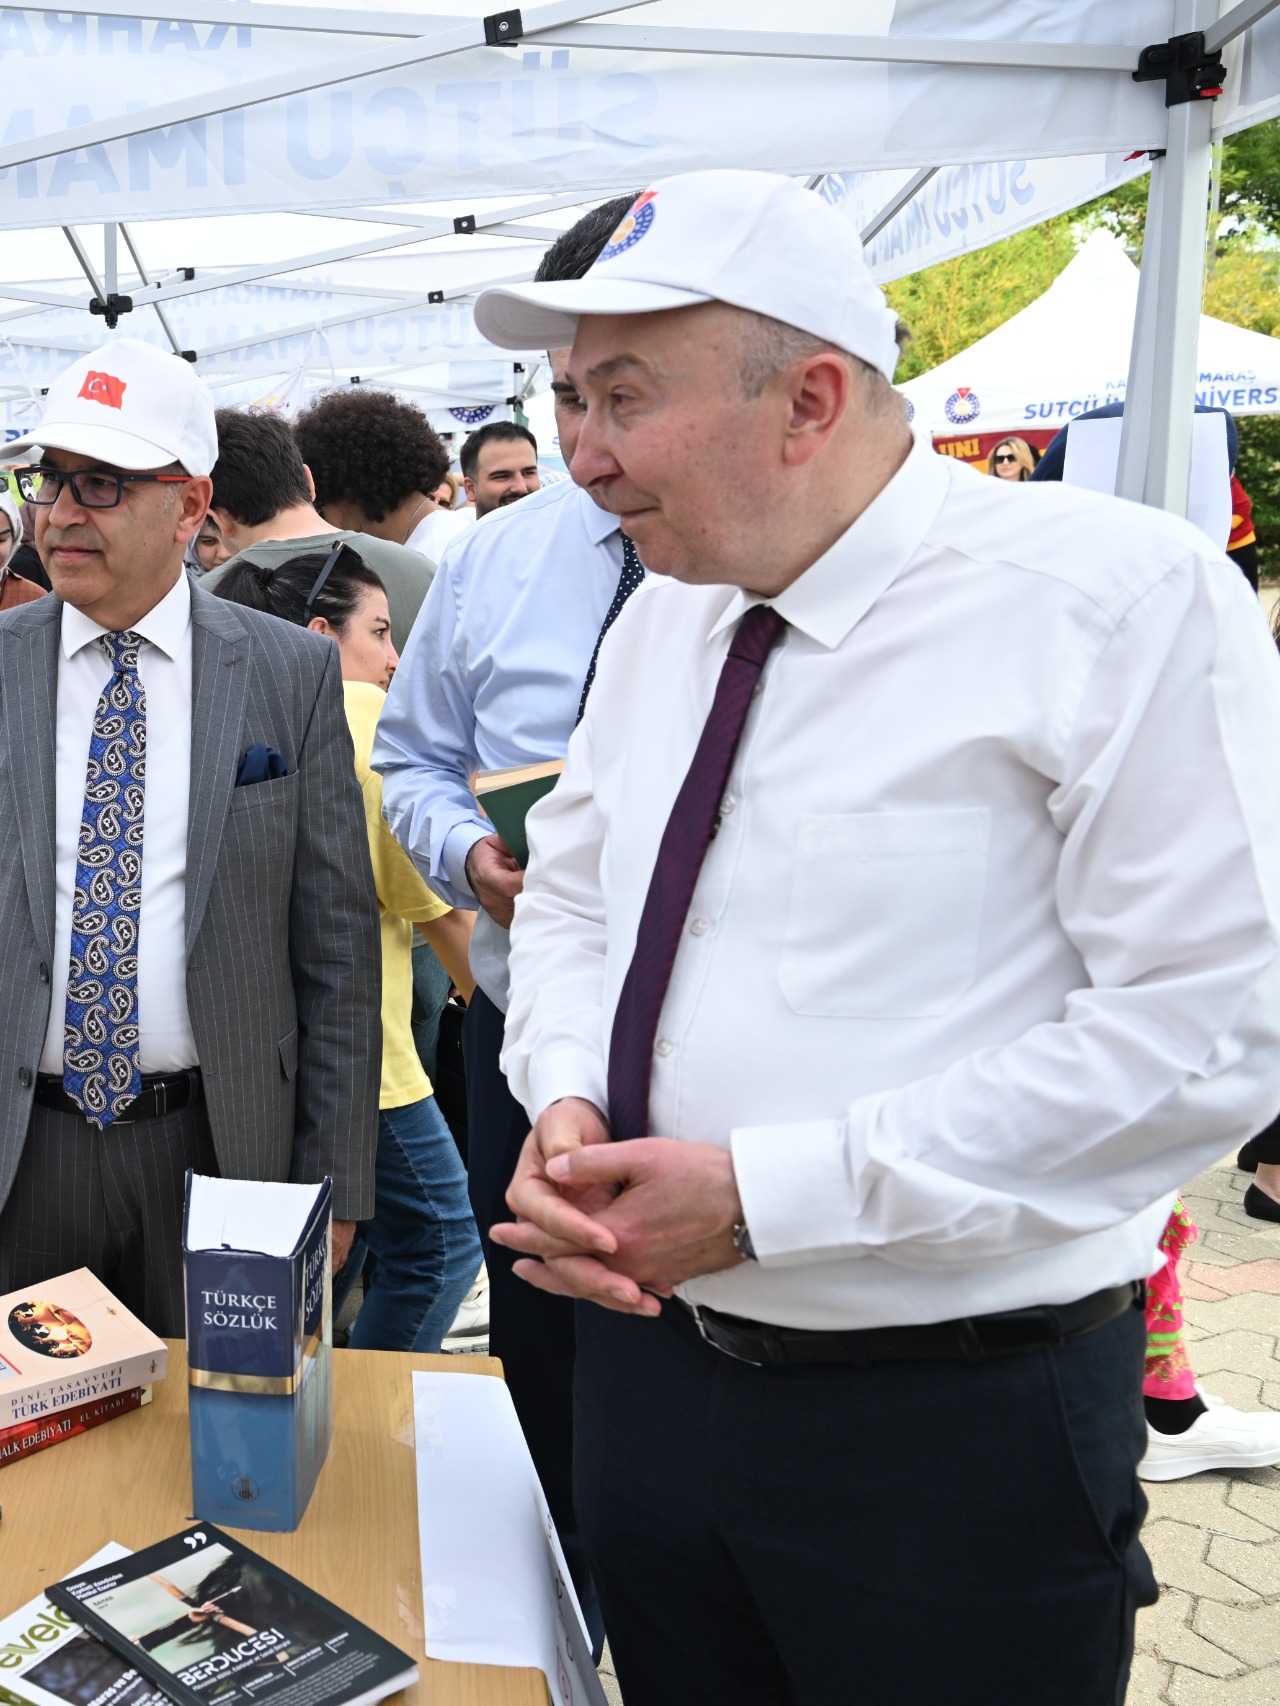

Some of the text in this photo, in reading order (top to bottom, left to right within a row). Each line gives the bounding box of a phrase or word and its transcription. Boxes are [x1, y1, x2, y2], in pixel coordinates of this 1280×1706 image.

[201, 1289, 277, 1313] TÜRKÇE
[203, 1310, 278, 1330] SÖZLÜK
[11, 1376, 123, 1420] TÜRK EDEBİYATI
[22, 1418, 72, 1450] EDEBİYATI
[80, 1412, 91, 1423] EL
